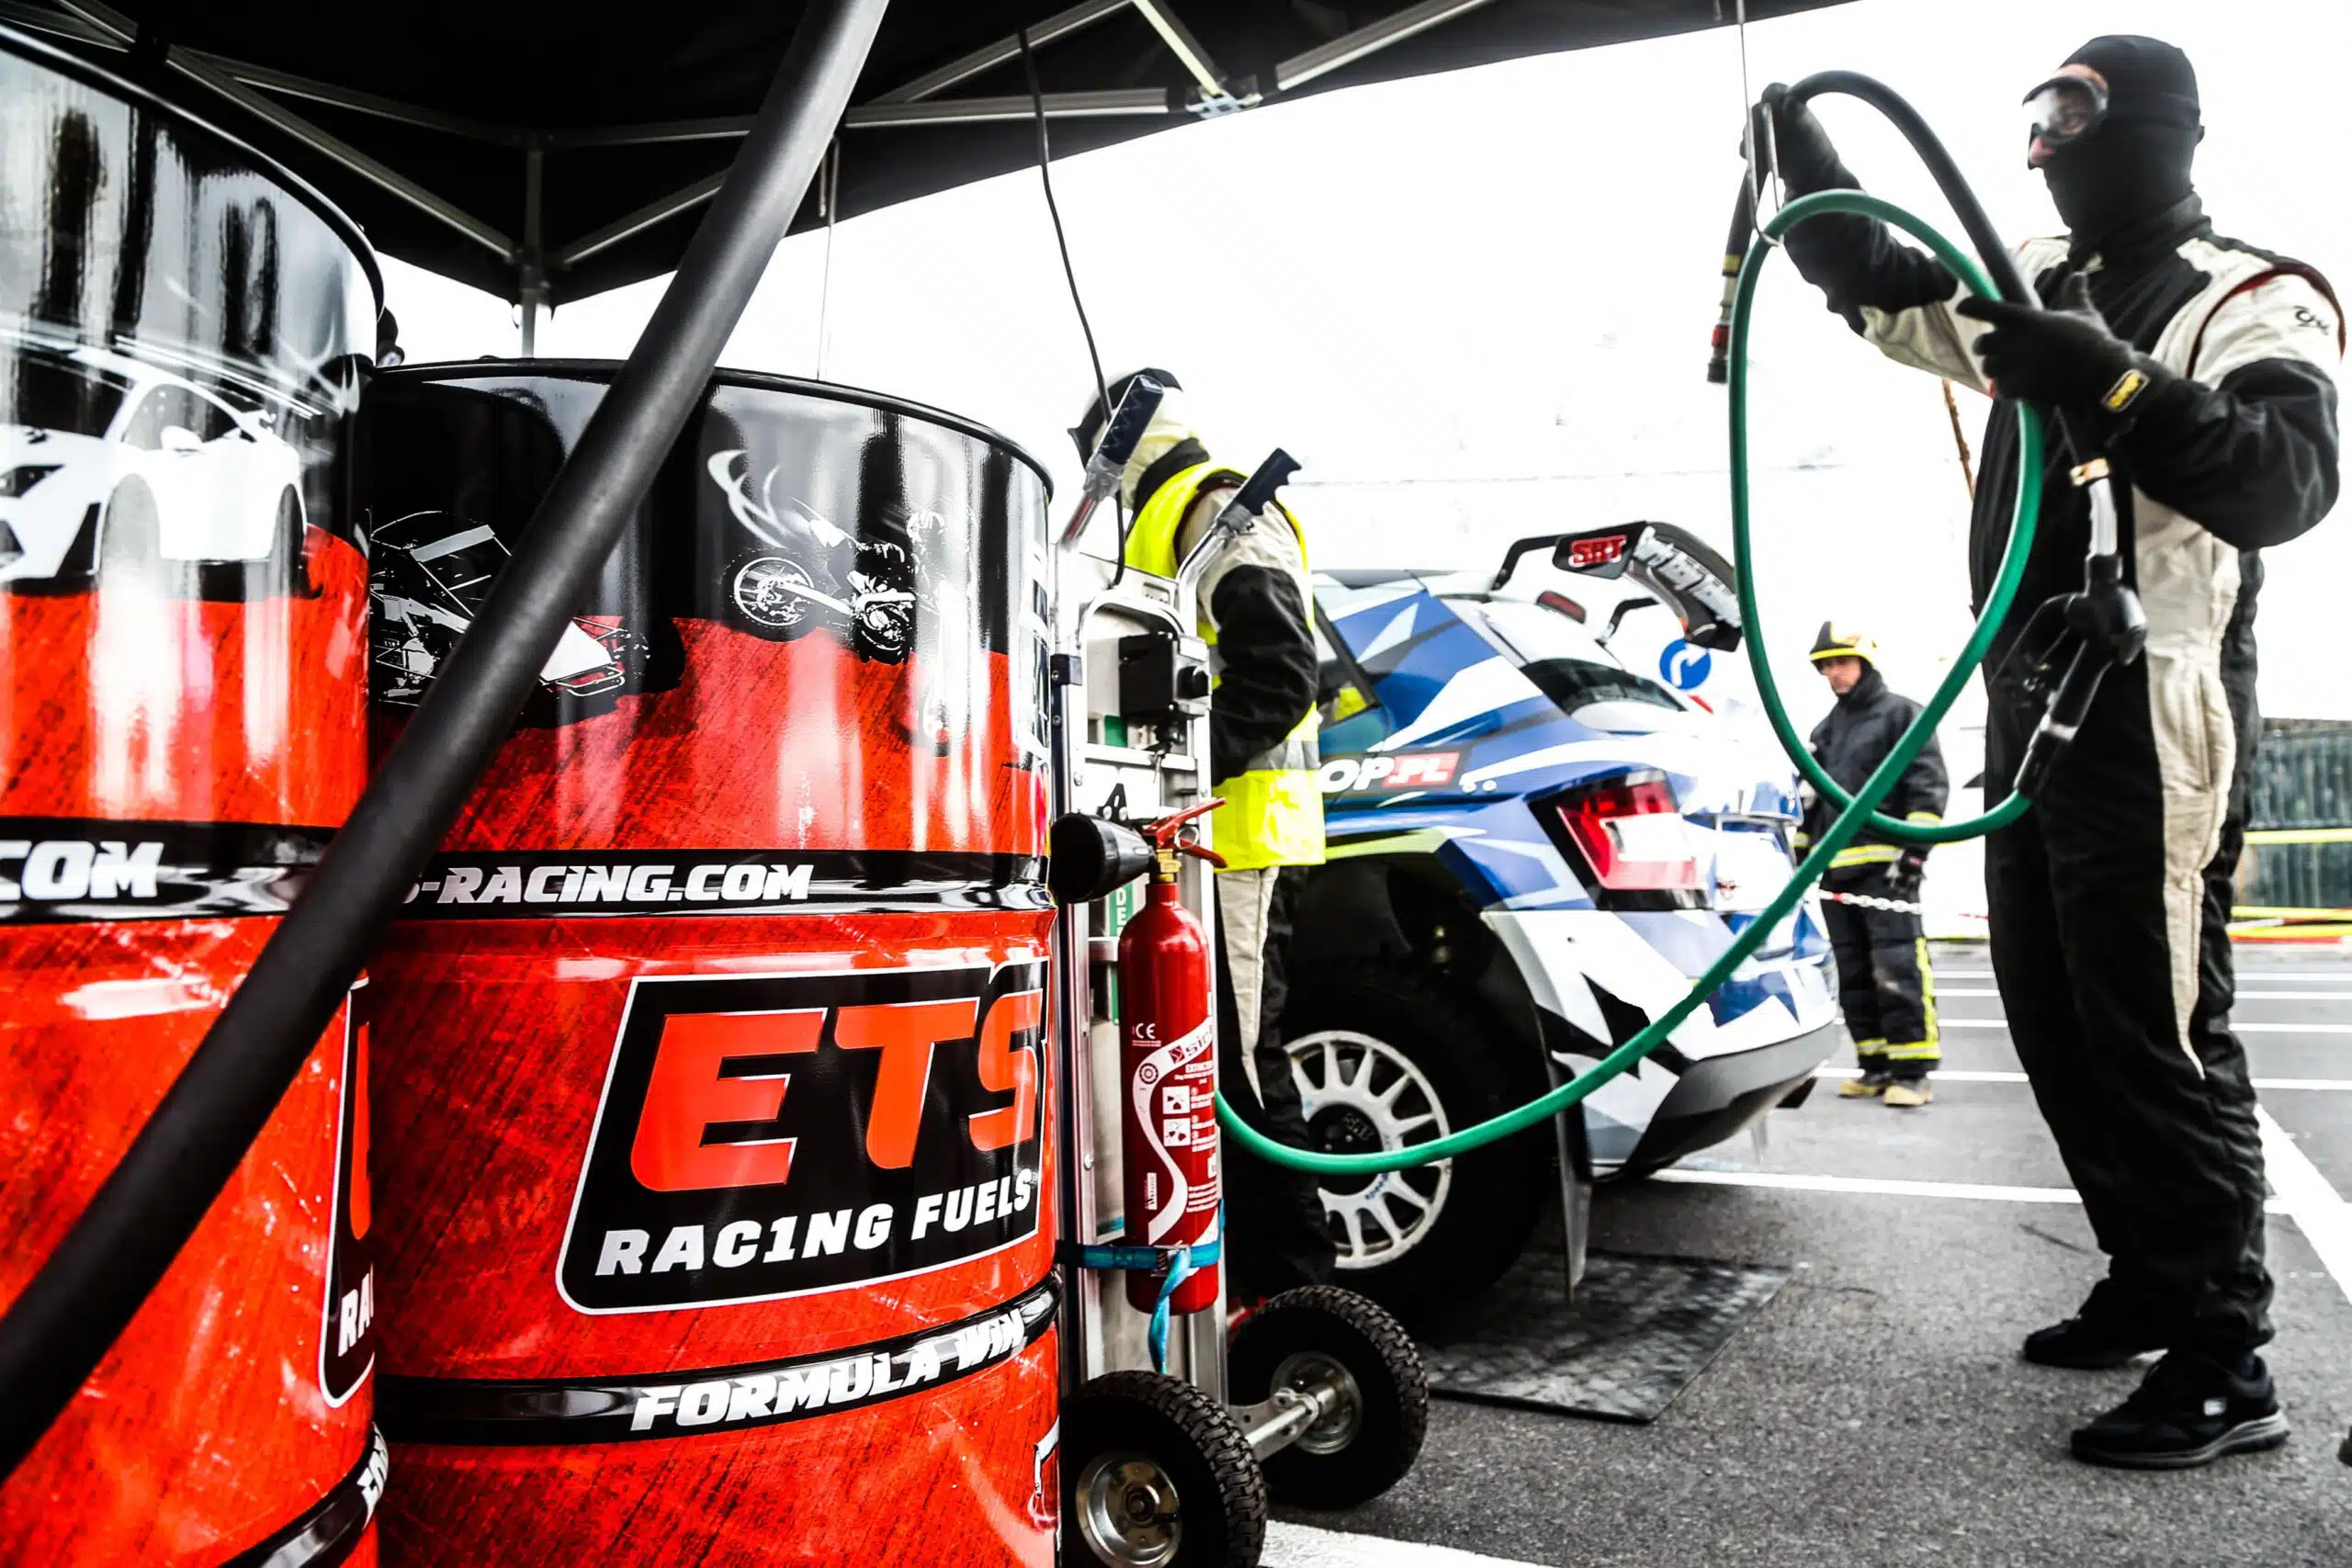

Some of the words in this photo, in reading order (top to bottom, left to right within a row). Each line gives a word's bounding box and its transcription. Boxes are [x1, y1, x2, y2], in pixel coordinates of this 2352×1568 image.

[404, 864, 814, 905] -RACING.COM
[630, 987, 1044, 1192] ETS
[911, 1168, 1033, 1242] FUELS
[630, 1344, 940, 1432] FORMULA
[956, 1308, 1026, 1369] WIN
